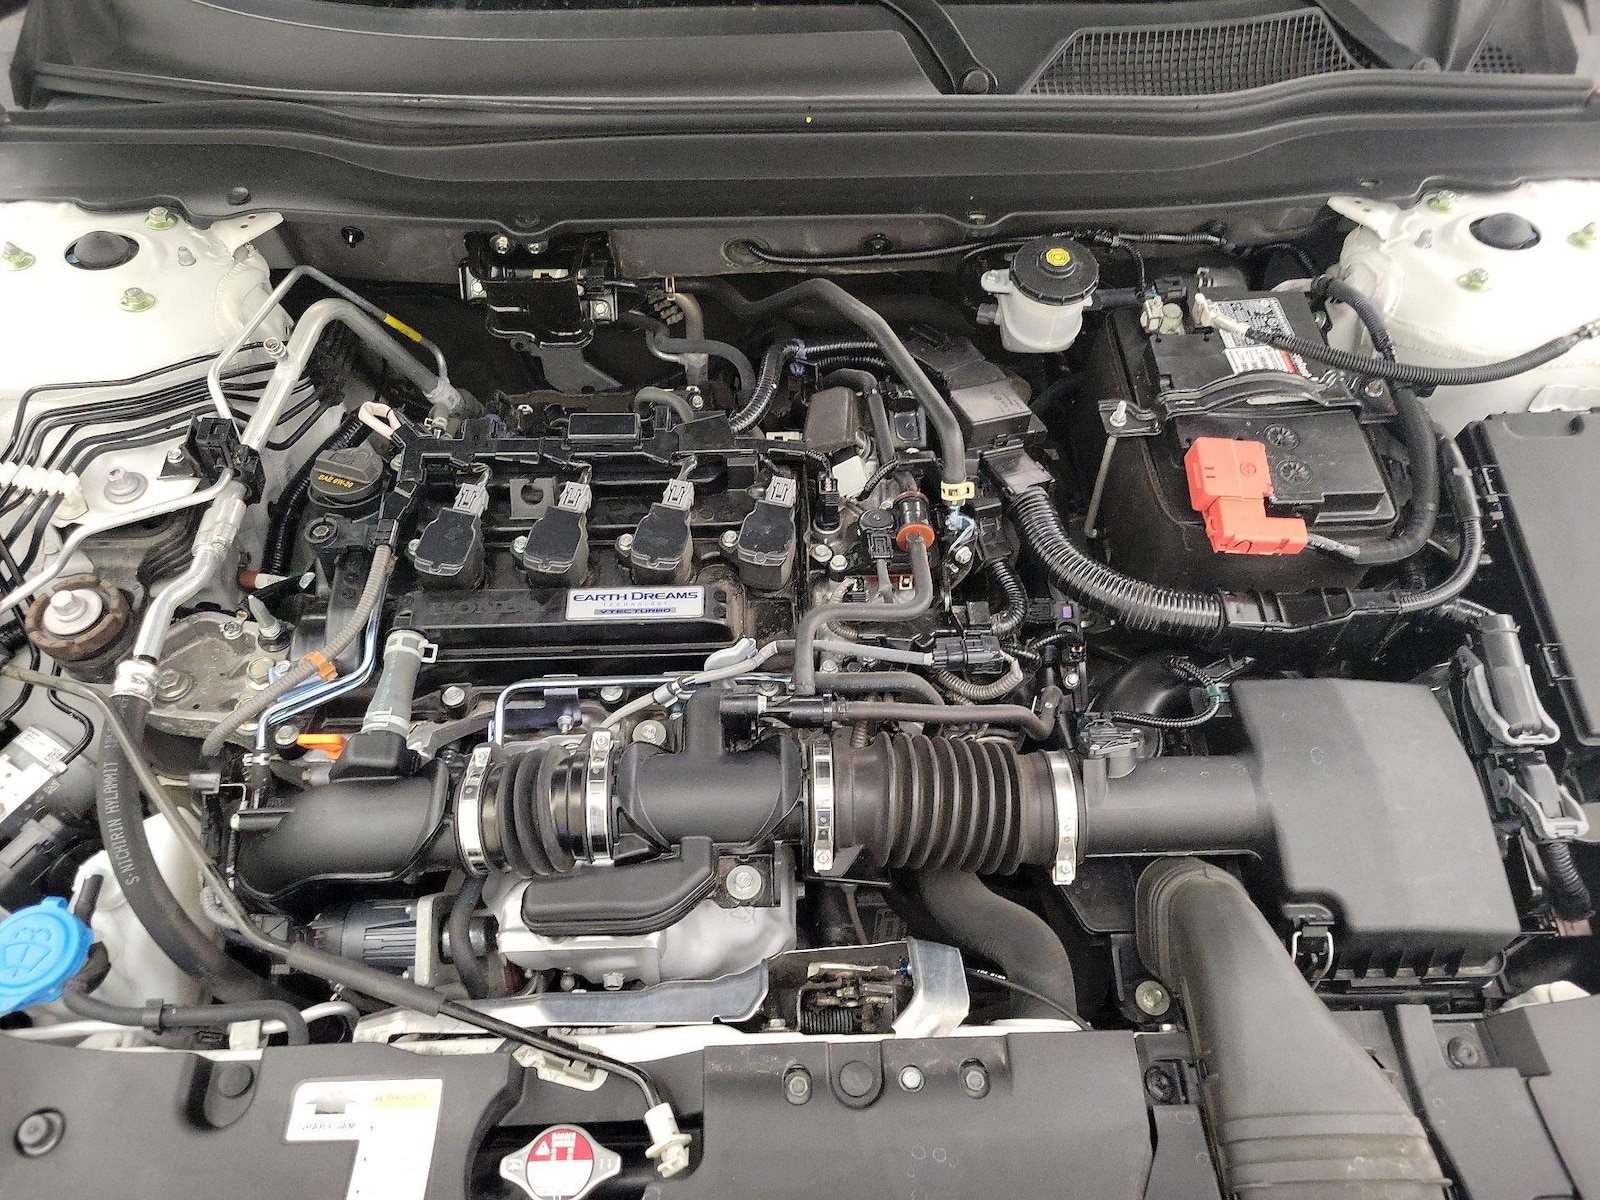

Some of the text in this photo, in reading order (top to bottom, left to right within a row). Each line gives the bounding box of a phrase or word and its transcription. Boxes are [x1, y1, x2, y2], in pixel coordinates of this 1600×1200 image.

[318, 474, 354, 488] SAE 0W-20
[573, 591, 698, 602] EARTH DREAMS
